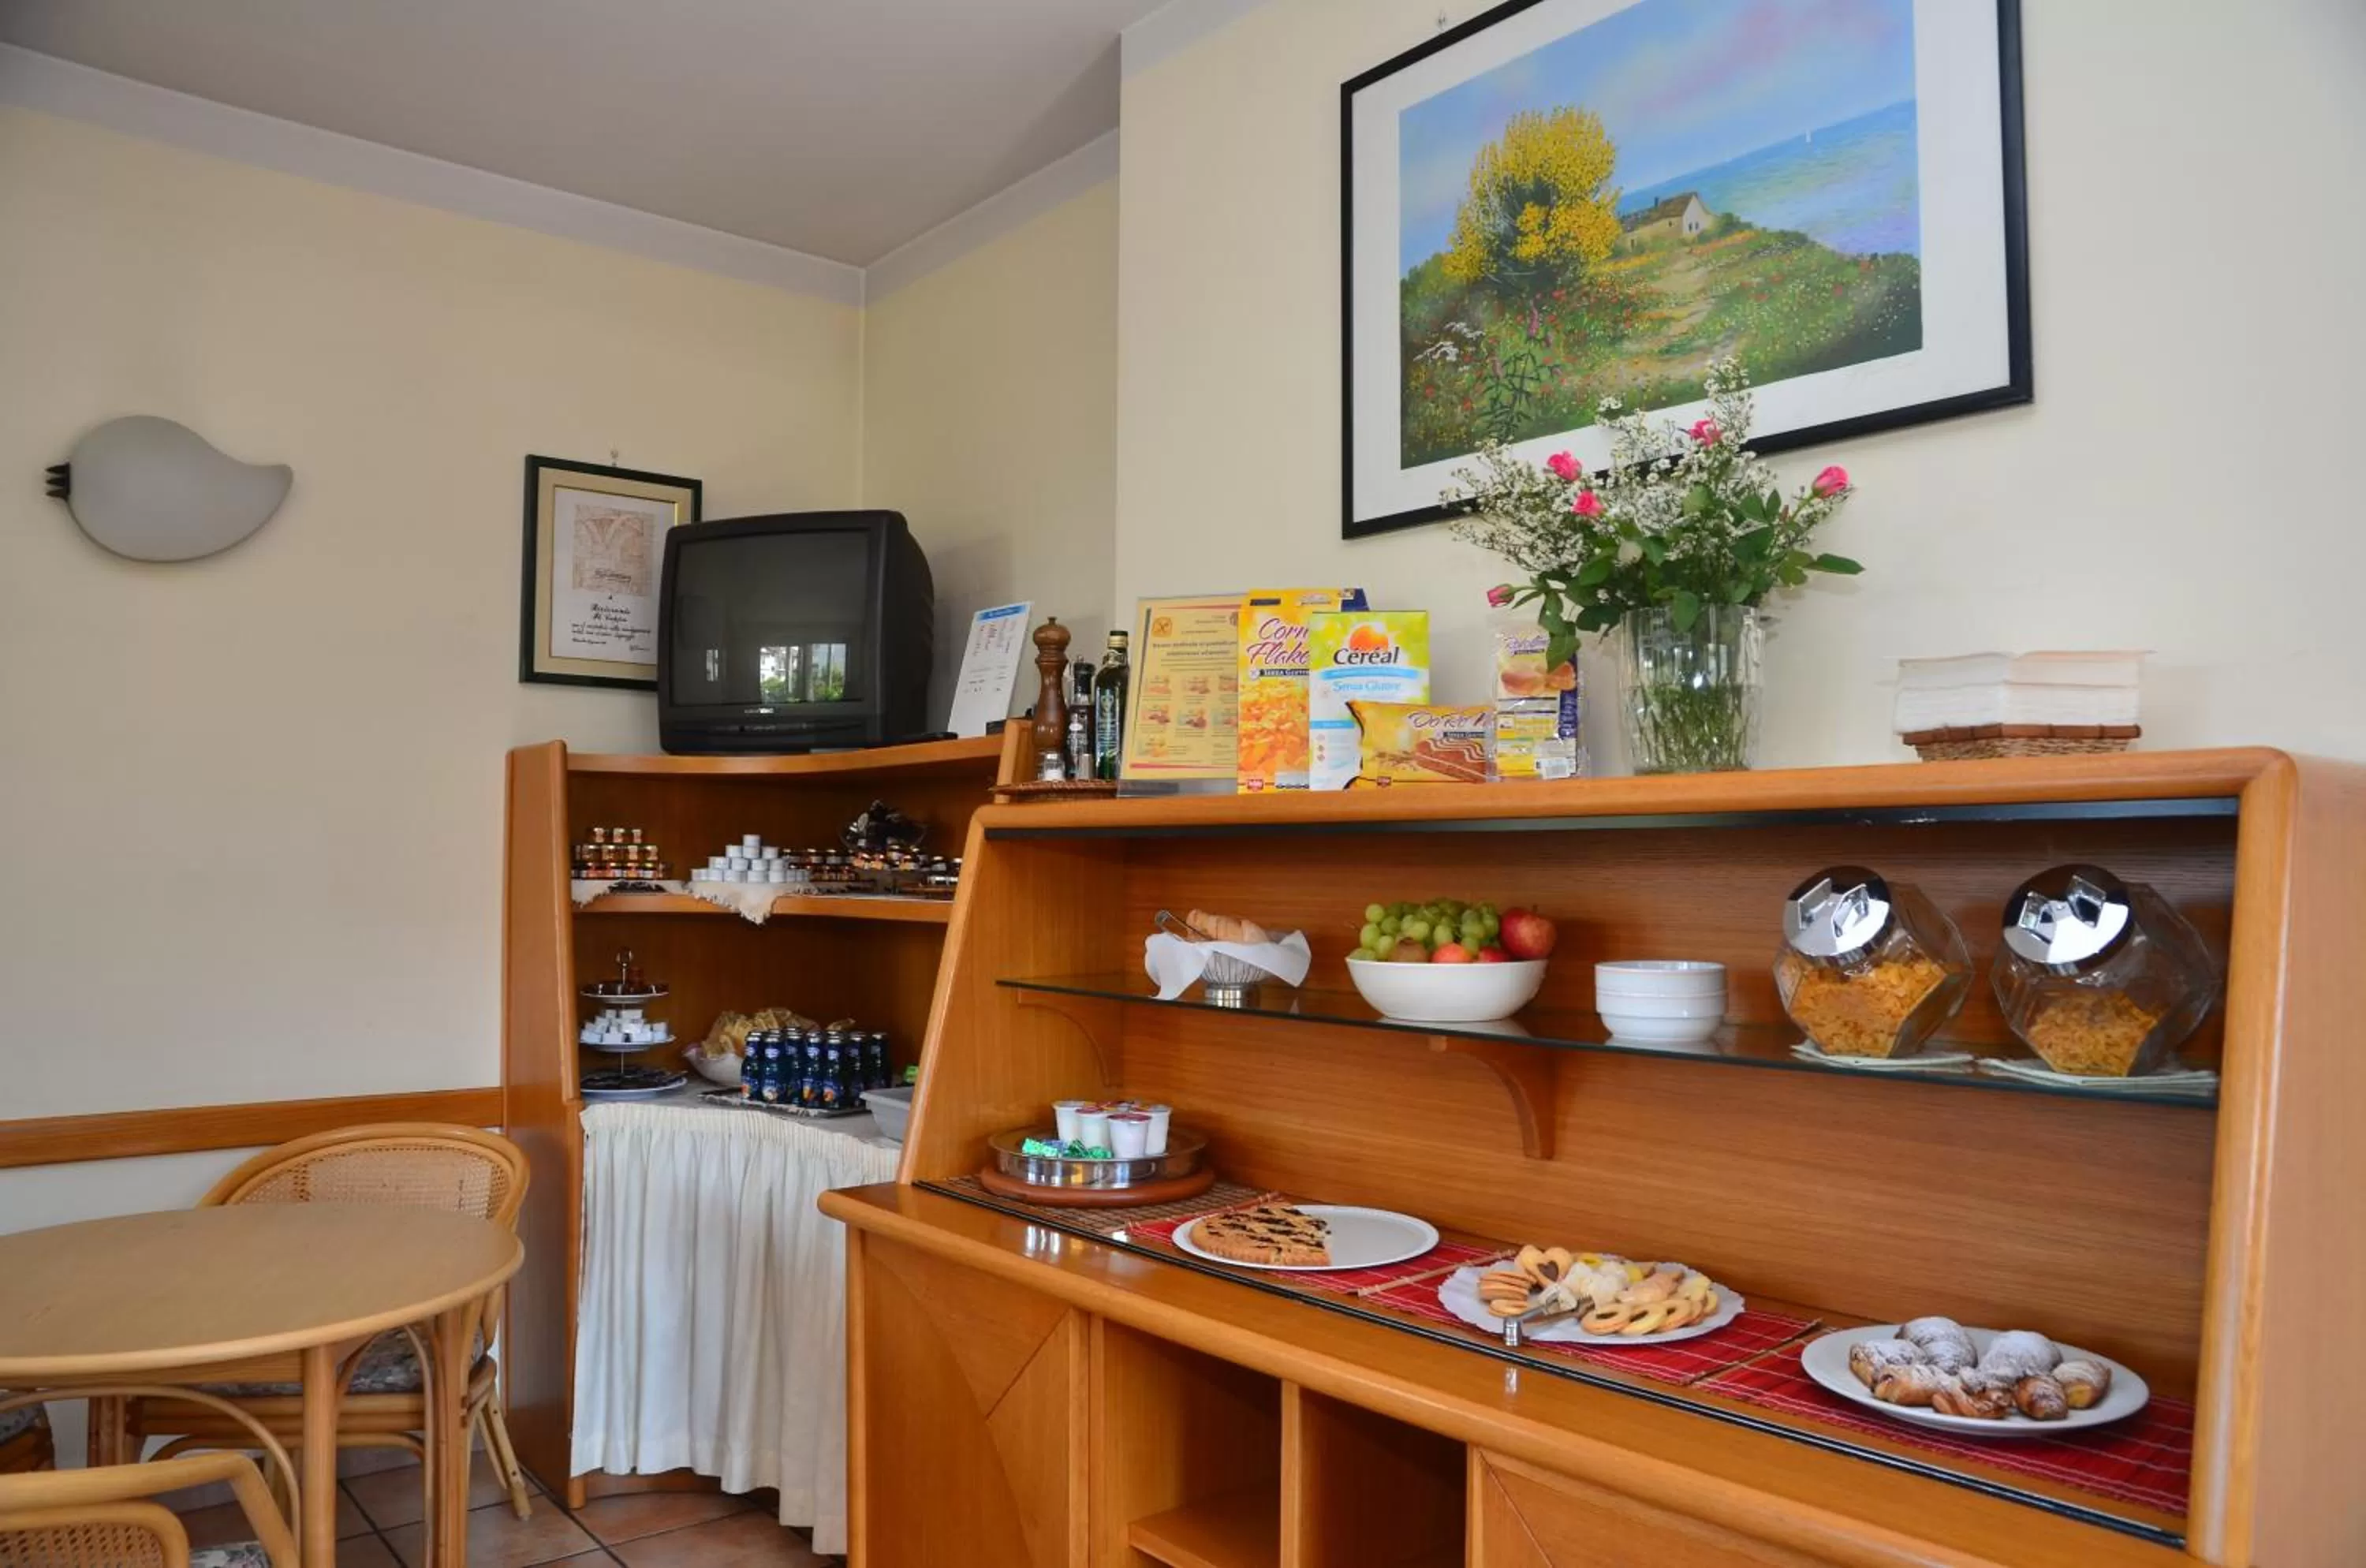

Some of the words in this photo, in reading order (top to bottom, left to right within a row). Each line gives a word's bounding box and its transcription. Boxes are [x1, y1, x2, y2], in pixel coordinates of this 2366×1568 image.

[1259, 618, 1309, 640] Corn
[1247, 640, 1309, 664] Flake
[1333, 646, 1399, 665] Céréal
